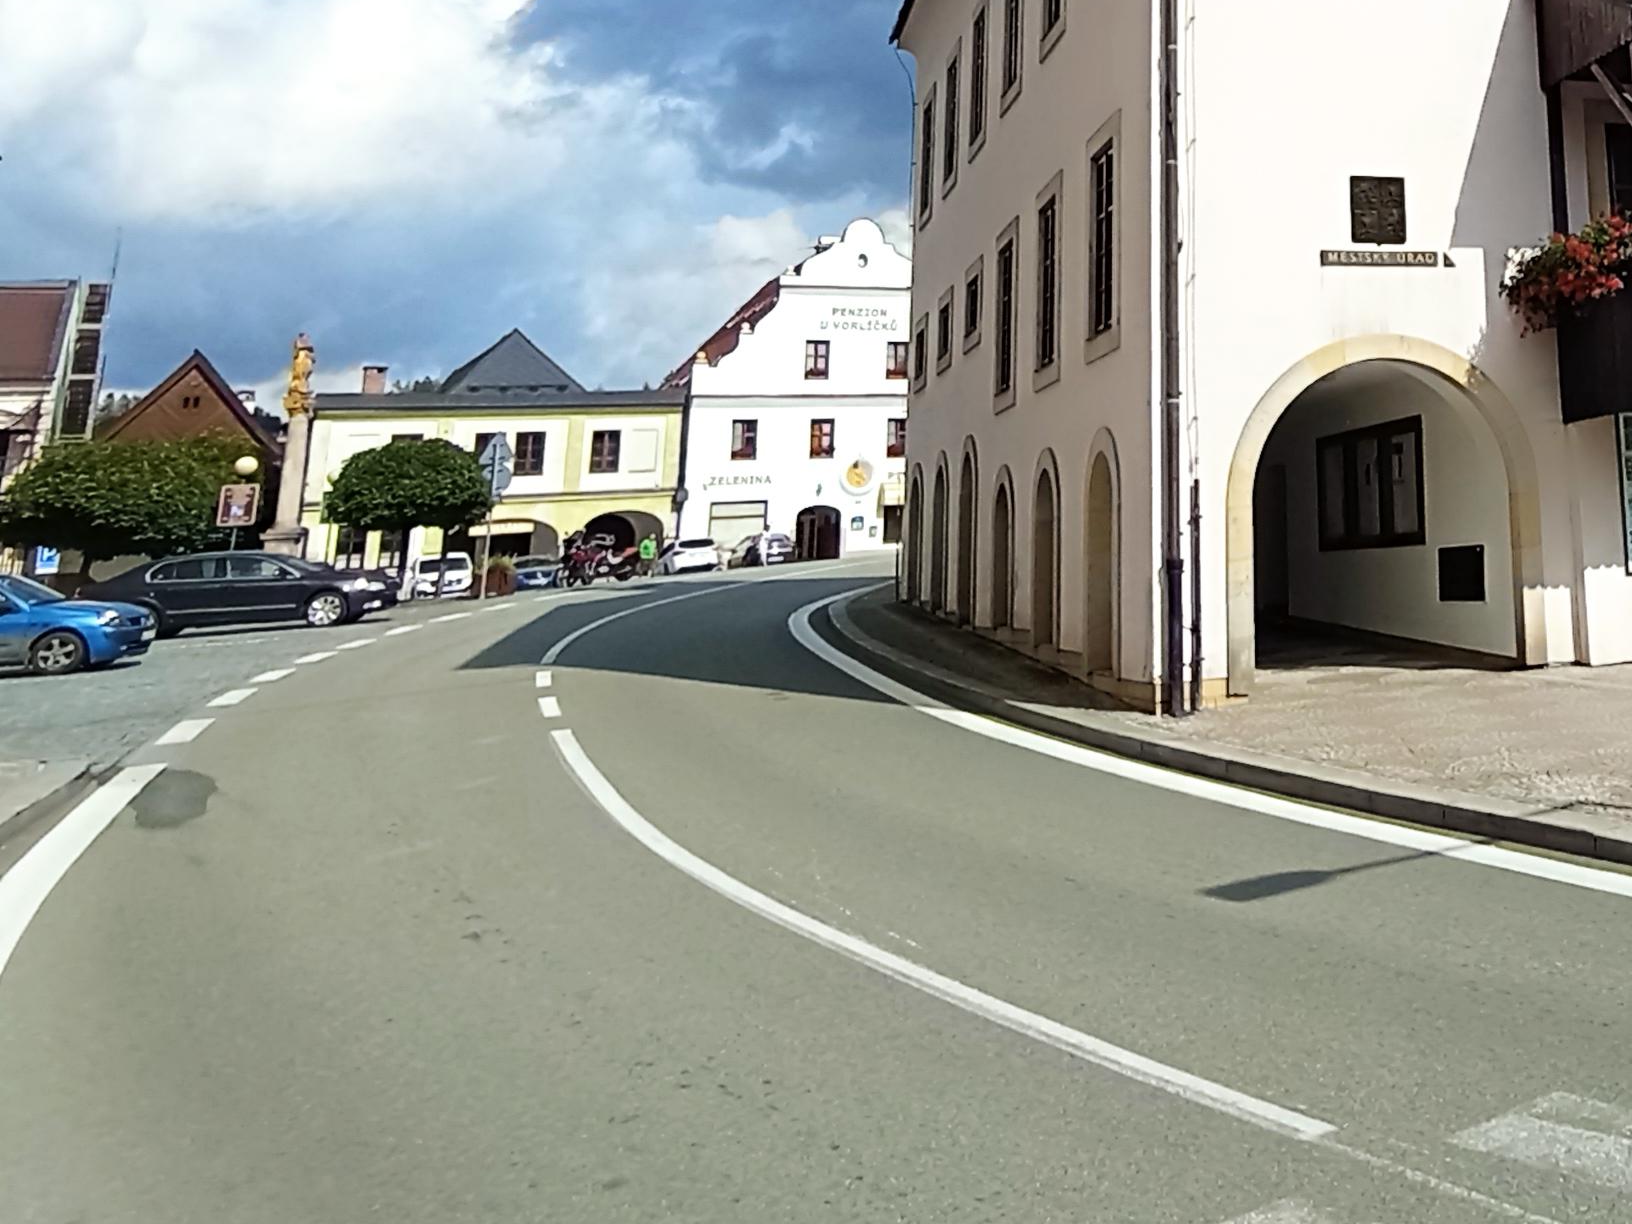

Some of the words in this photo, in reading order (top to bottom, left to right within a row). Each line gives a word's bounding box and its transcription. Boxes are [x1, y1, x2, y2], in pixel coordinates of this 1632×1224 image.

[832, 307, 887, 317] PENZION
[820, 320, 828, 330] U
[707, 475, 772, 487] ZELENINA
